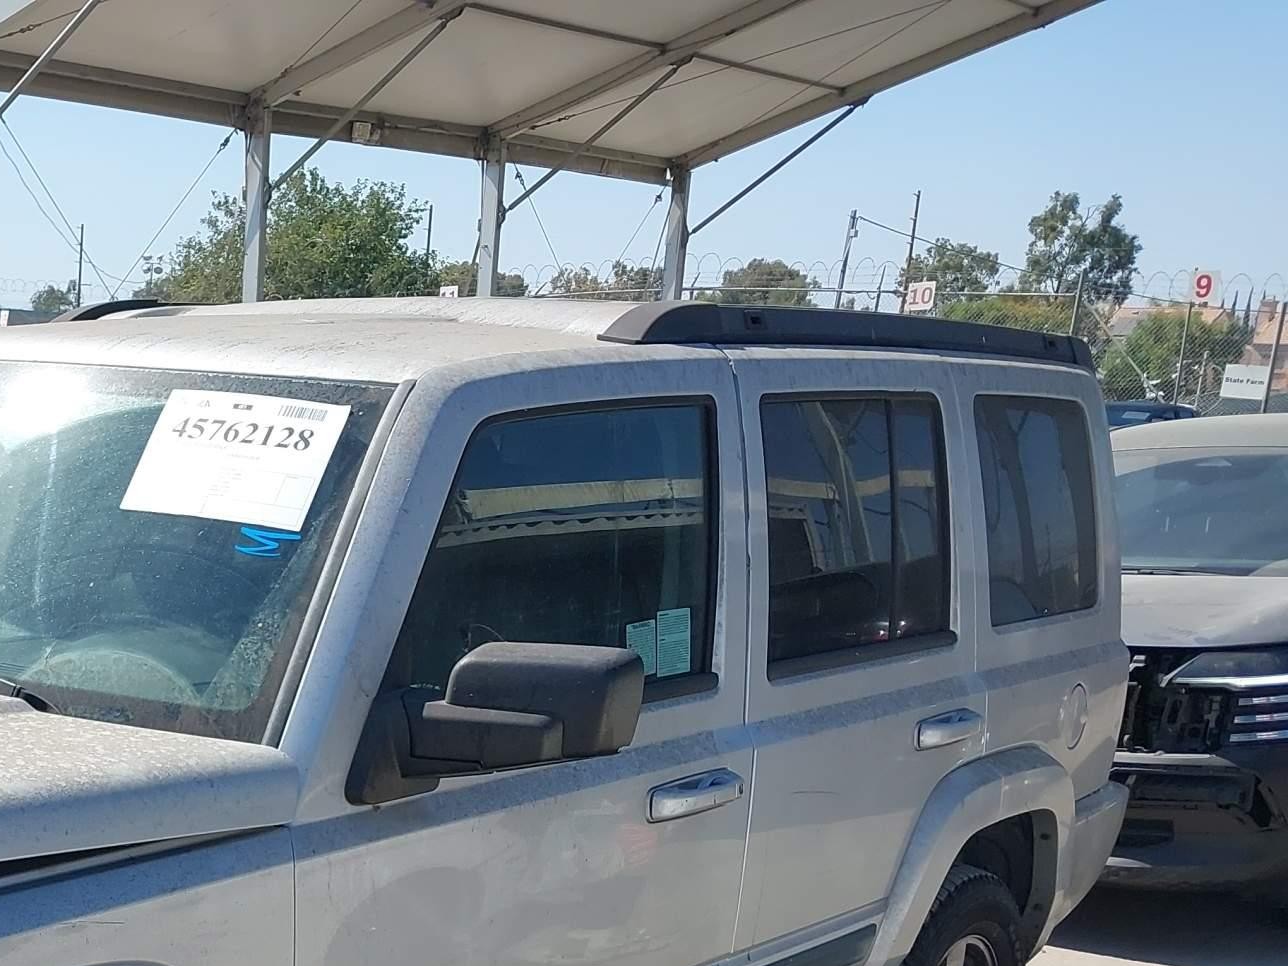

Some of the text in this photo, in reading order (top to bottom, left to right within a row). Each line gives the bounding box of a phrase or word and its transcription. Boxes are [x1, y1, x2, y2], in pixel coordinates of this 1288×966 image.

[909, 286, 933, 304] 10
[1195, 274, 1212, 298] 9
[171, 416, 315, 451] 45762128
